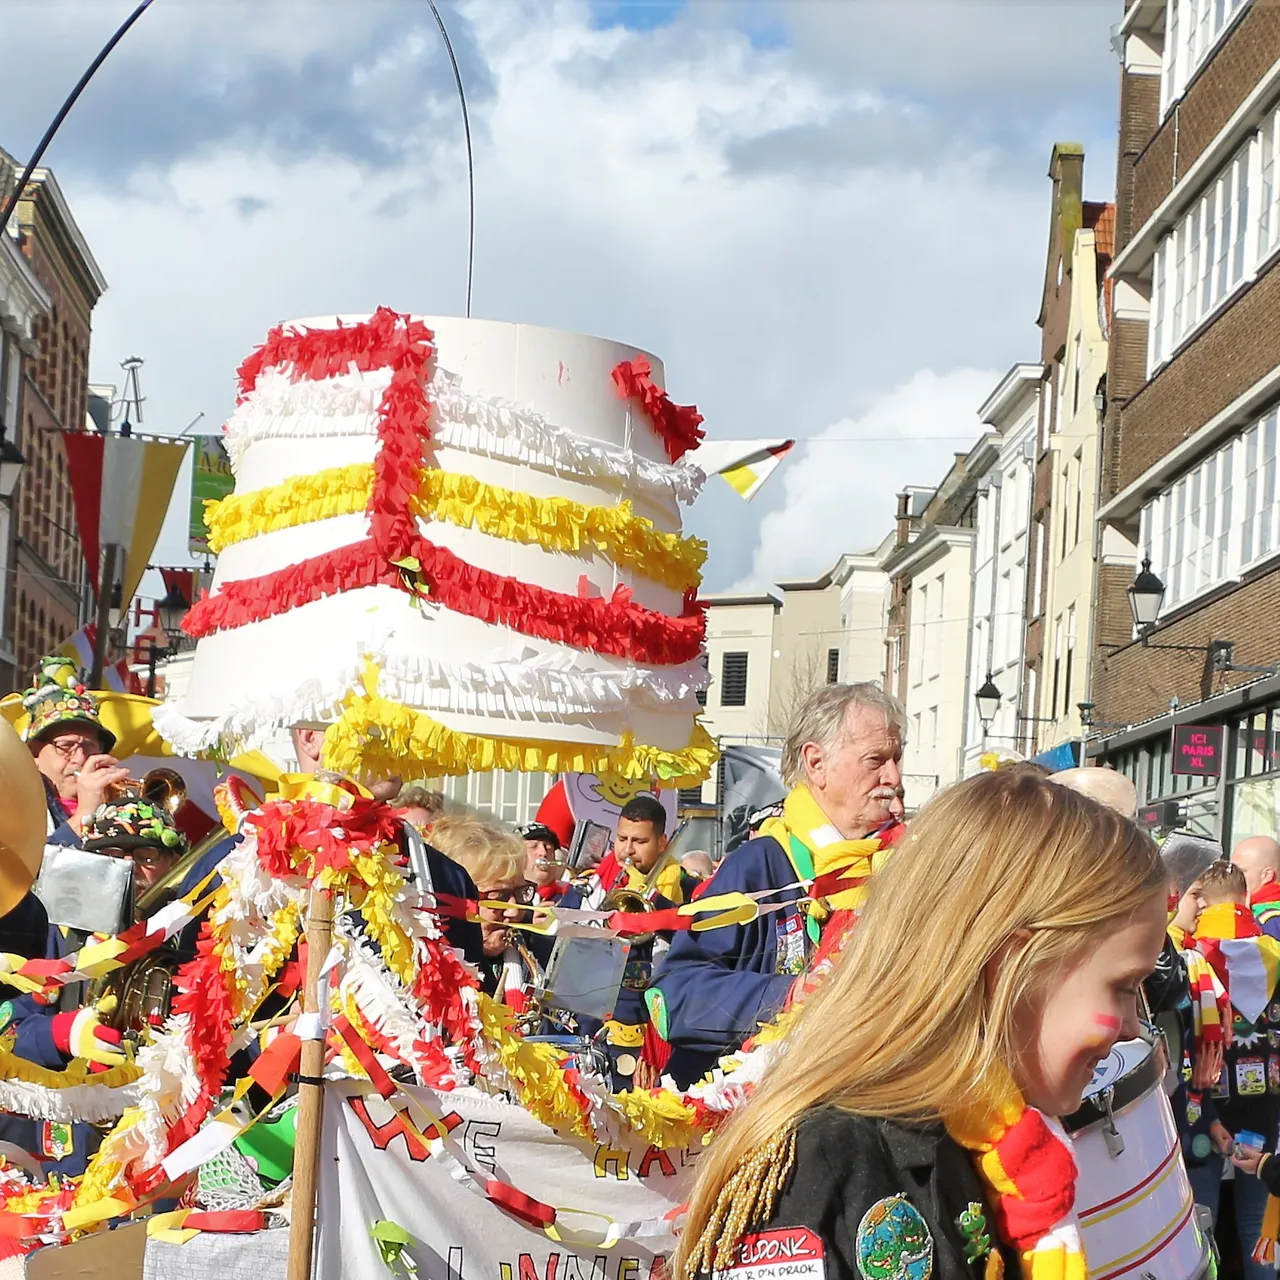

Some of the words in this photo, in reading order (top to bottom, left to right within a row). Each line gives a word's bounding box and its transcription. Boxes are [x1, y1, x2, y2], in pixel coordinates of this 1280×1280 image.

[1191, 733, 1207, 744] ICI
[1182, 745, 1214, 756] PARIS
[1190, 757, 1206, 768] XL
[347, 1096, 502, 1174] WE
[734, 1235, 816, 1264] ELDONK.
[778, 1263, 818, 1275] DRAOK
